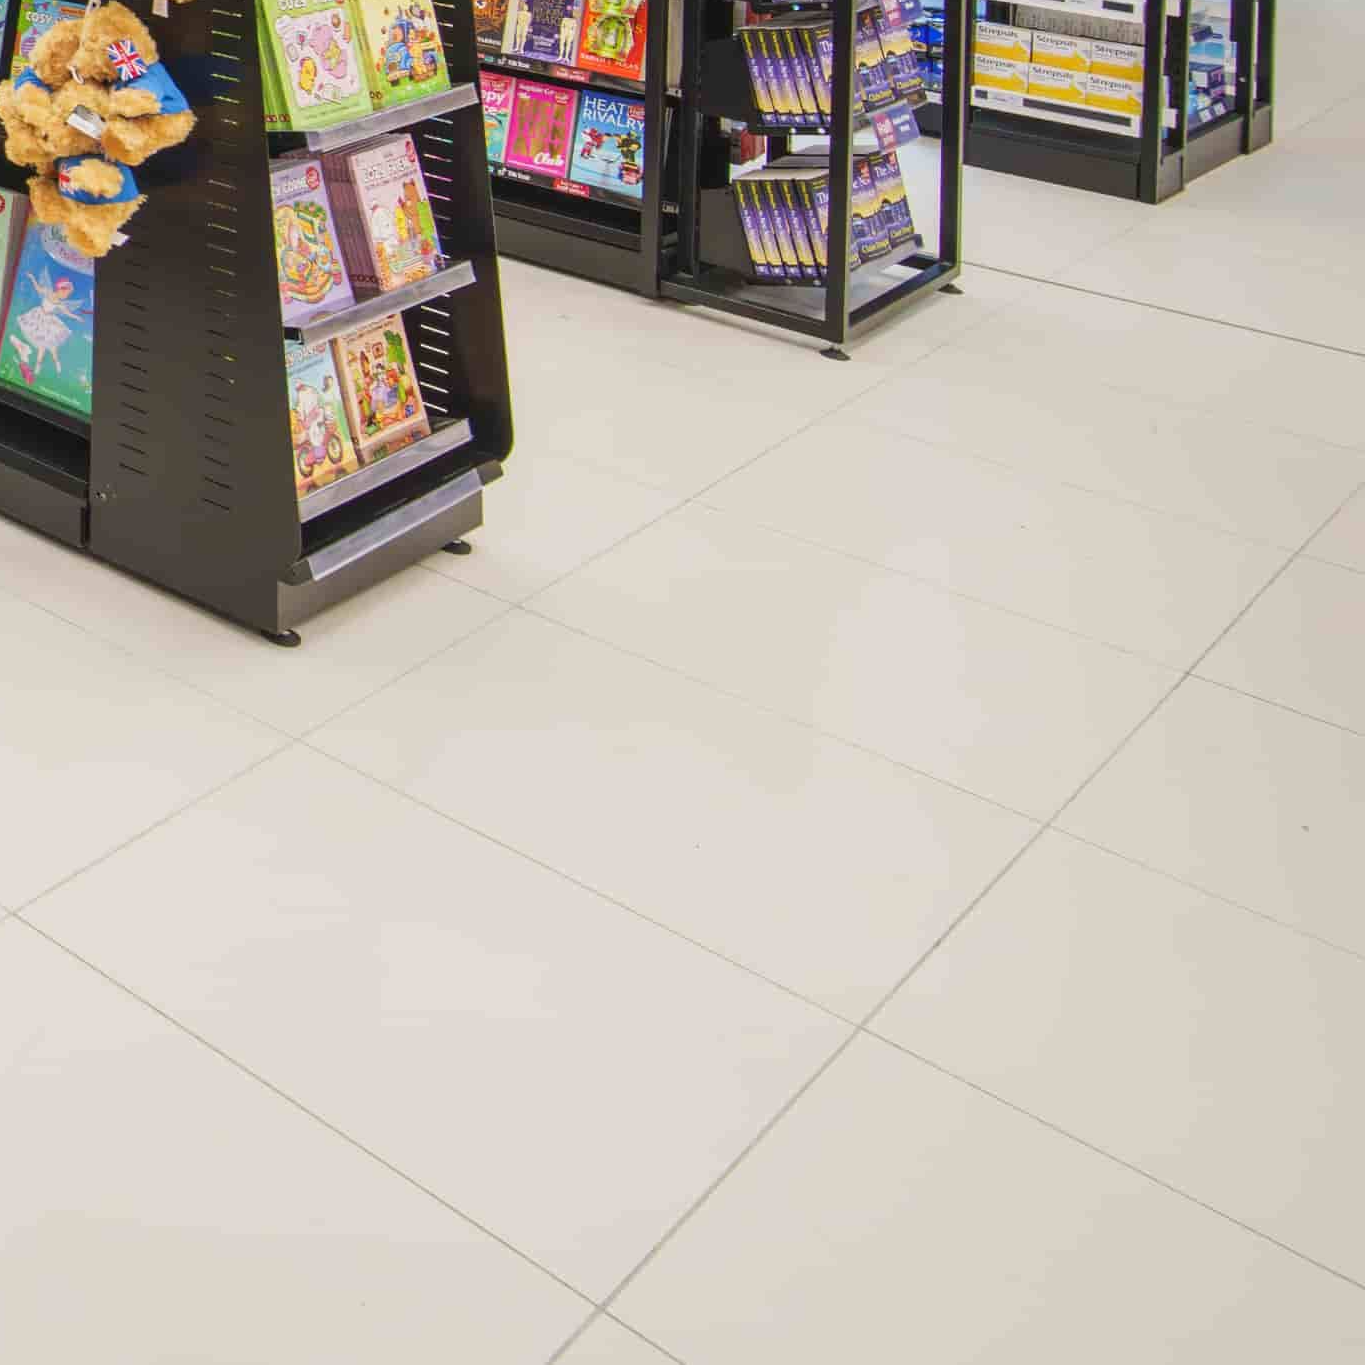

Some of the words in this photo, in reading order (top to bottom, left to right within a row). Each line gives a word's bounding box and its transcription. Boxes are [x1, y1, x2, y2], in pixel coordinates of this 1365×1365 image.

[977, 25, 1019, 39] Strepsils
[1035, 33, 1078, 48] Strepsils
[1094, 44, 1138, 59] Strepsils
[976, 55, 1017, 70] Strepsils
[1032, 65, 1074, 81] Strepsils
[1089, 75, 1133, 91] Strepsils
[584, 94, 635, 116] HEAT
[583, 109, 646, 132] RIVALRY
[533, 152, 565, 167] Club
